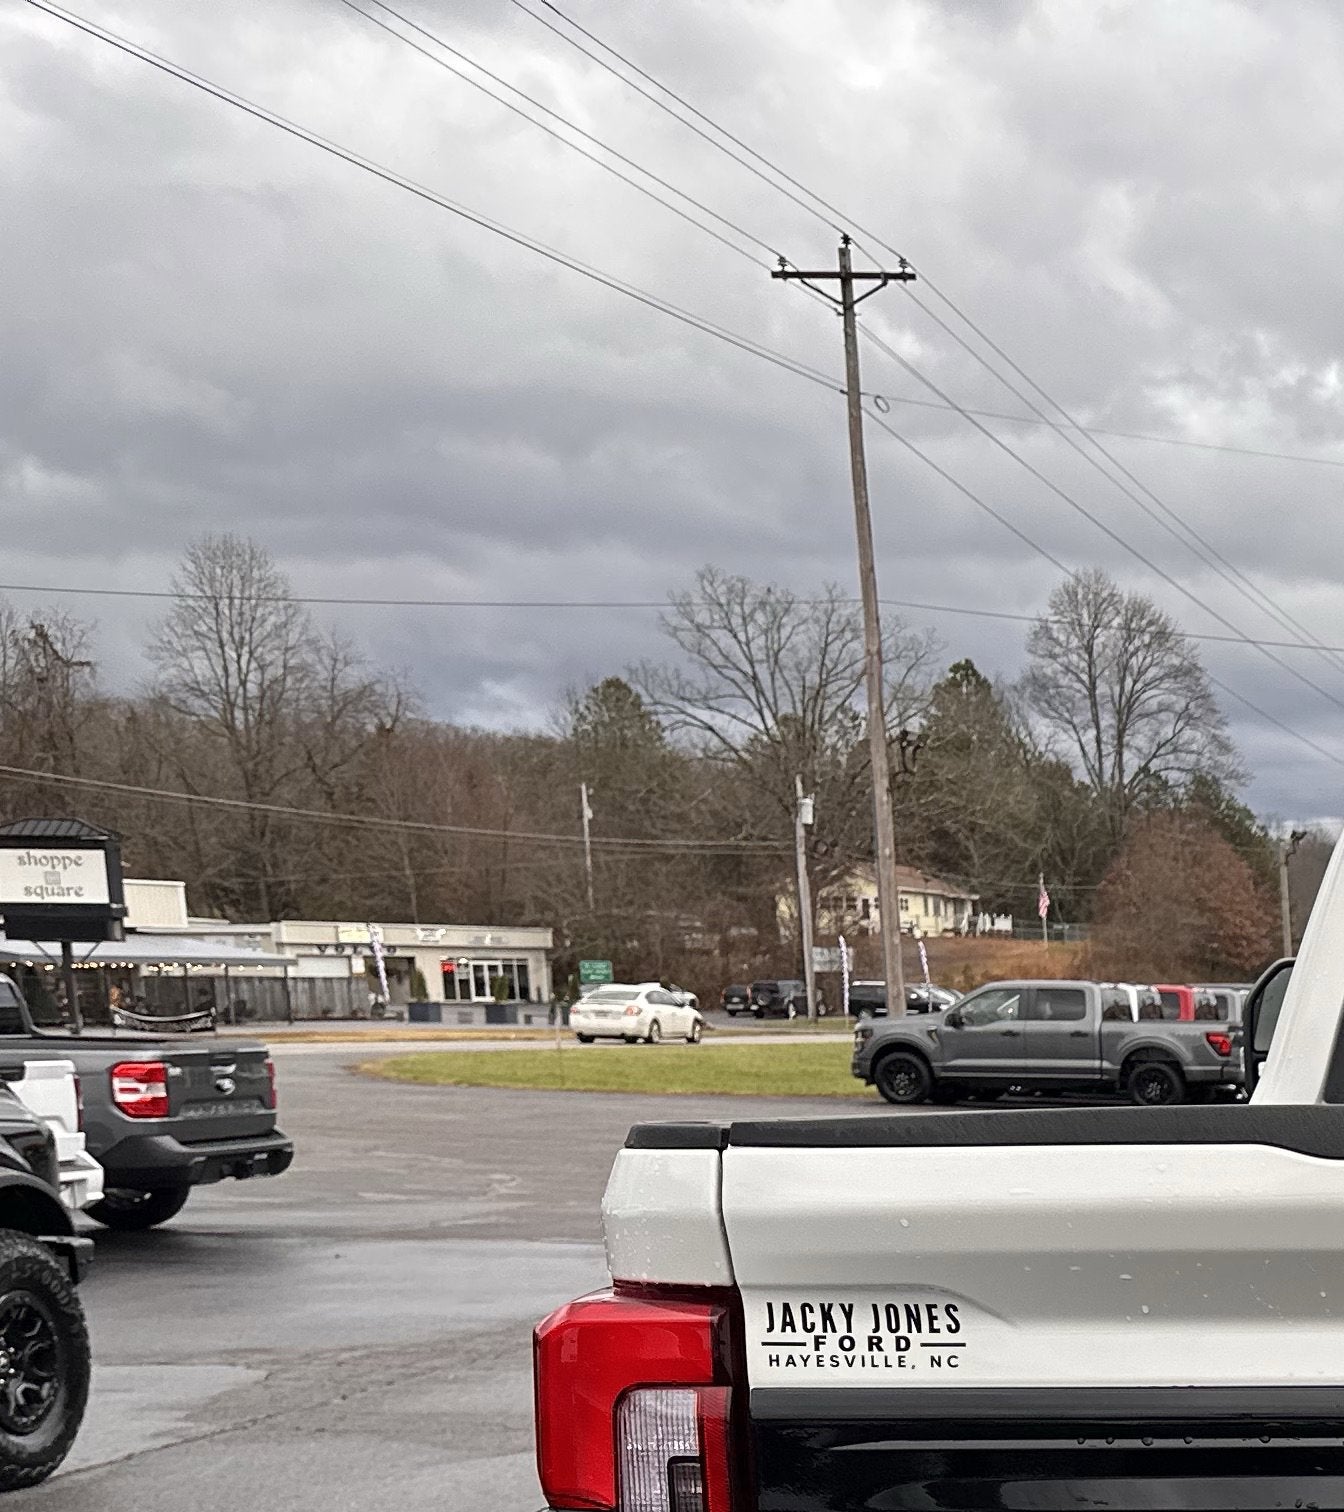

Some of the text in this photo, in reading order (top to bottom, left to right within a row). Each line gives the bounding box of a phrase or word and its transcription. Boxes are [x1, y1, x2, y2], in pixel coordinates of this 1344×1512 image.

[17, 850, 84, 870] shoppe
[23, 883, 85, 900] square
[766, 1302, 961, 1334] JACKY JONES
[813, 1334, 912, 1352] FORD
[768, 1354, 960, 1370] HAYESVILLE, NC
